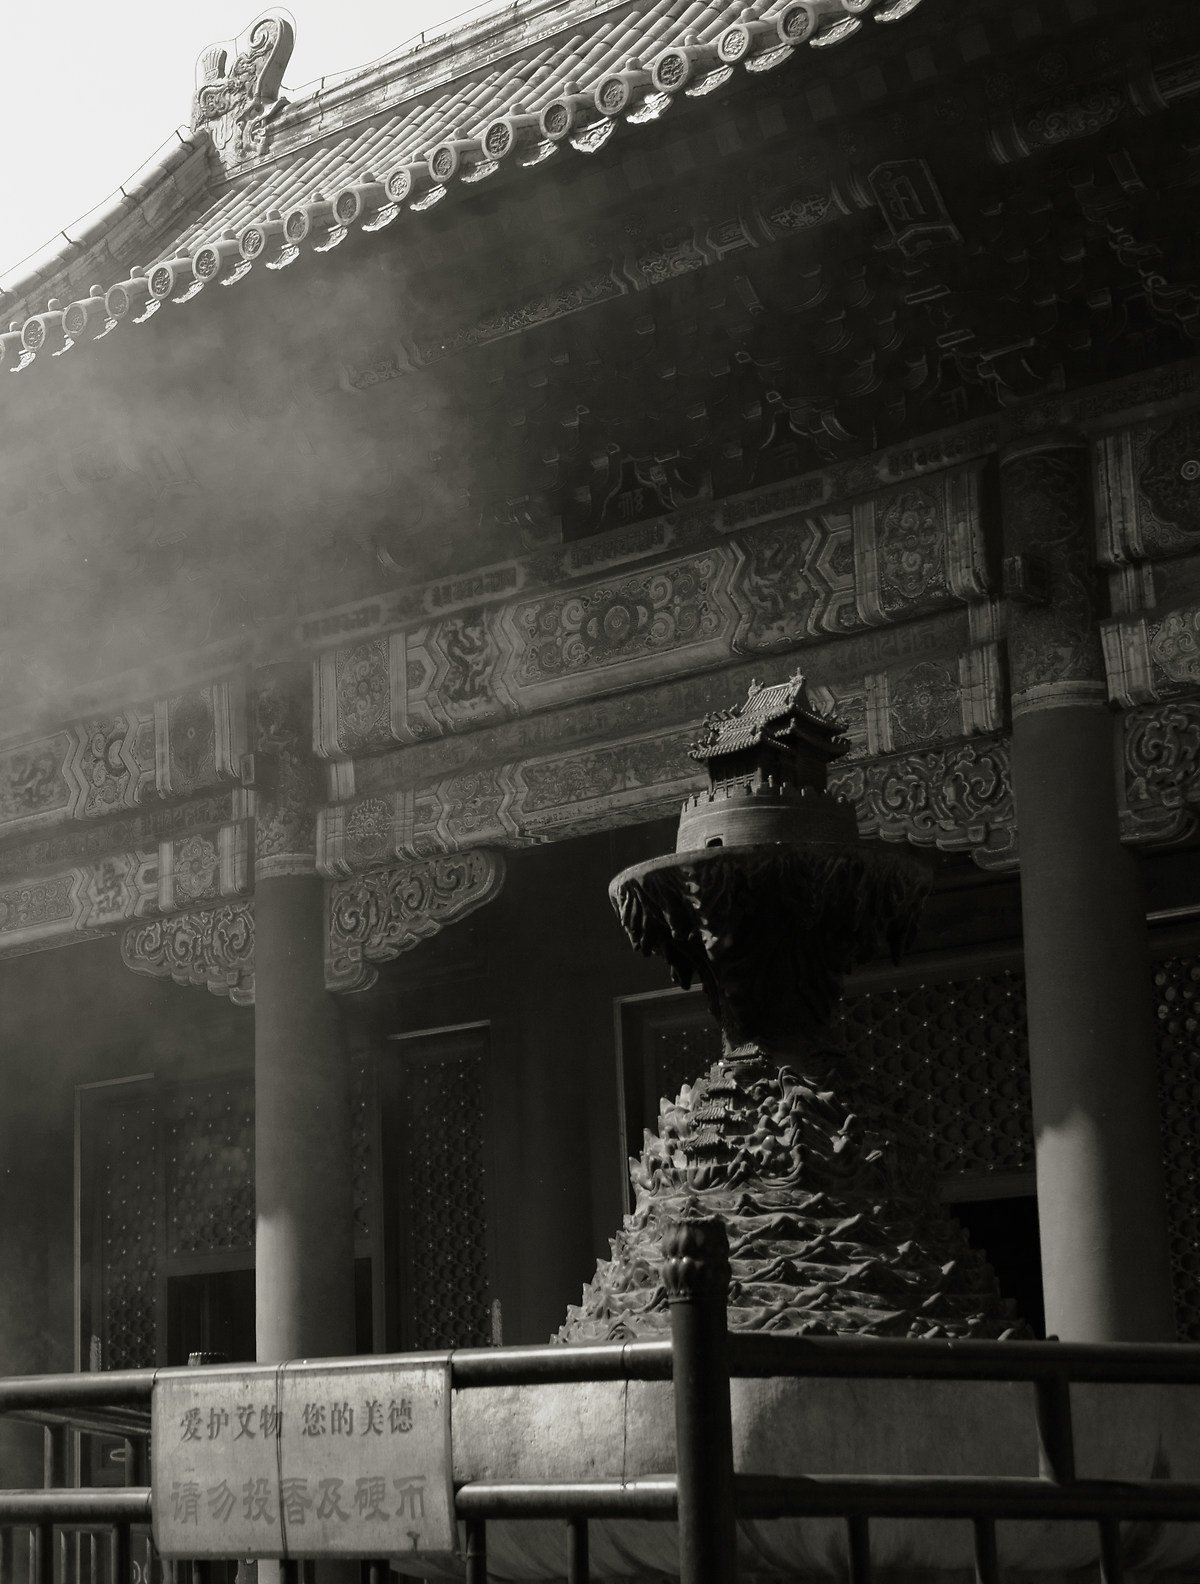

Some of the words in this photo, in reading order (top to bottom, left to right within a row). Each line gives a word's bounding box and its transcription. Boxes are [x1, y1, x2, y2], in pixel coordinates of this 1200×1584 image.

[180, 1403, 283, 1440] 爱护文物
[302, 1399, 413, 1438] 您的美德
[171, 1475, 426, 1526] 请勿投香及硬币
